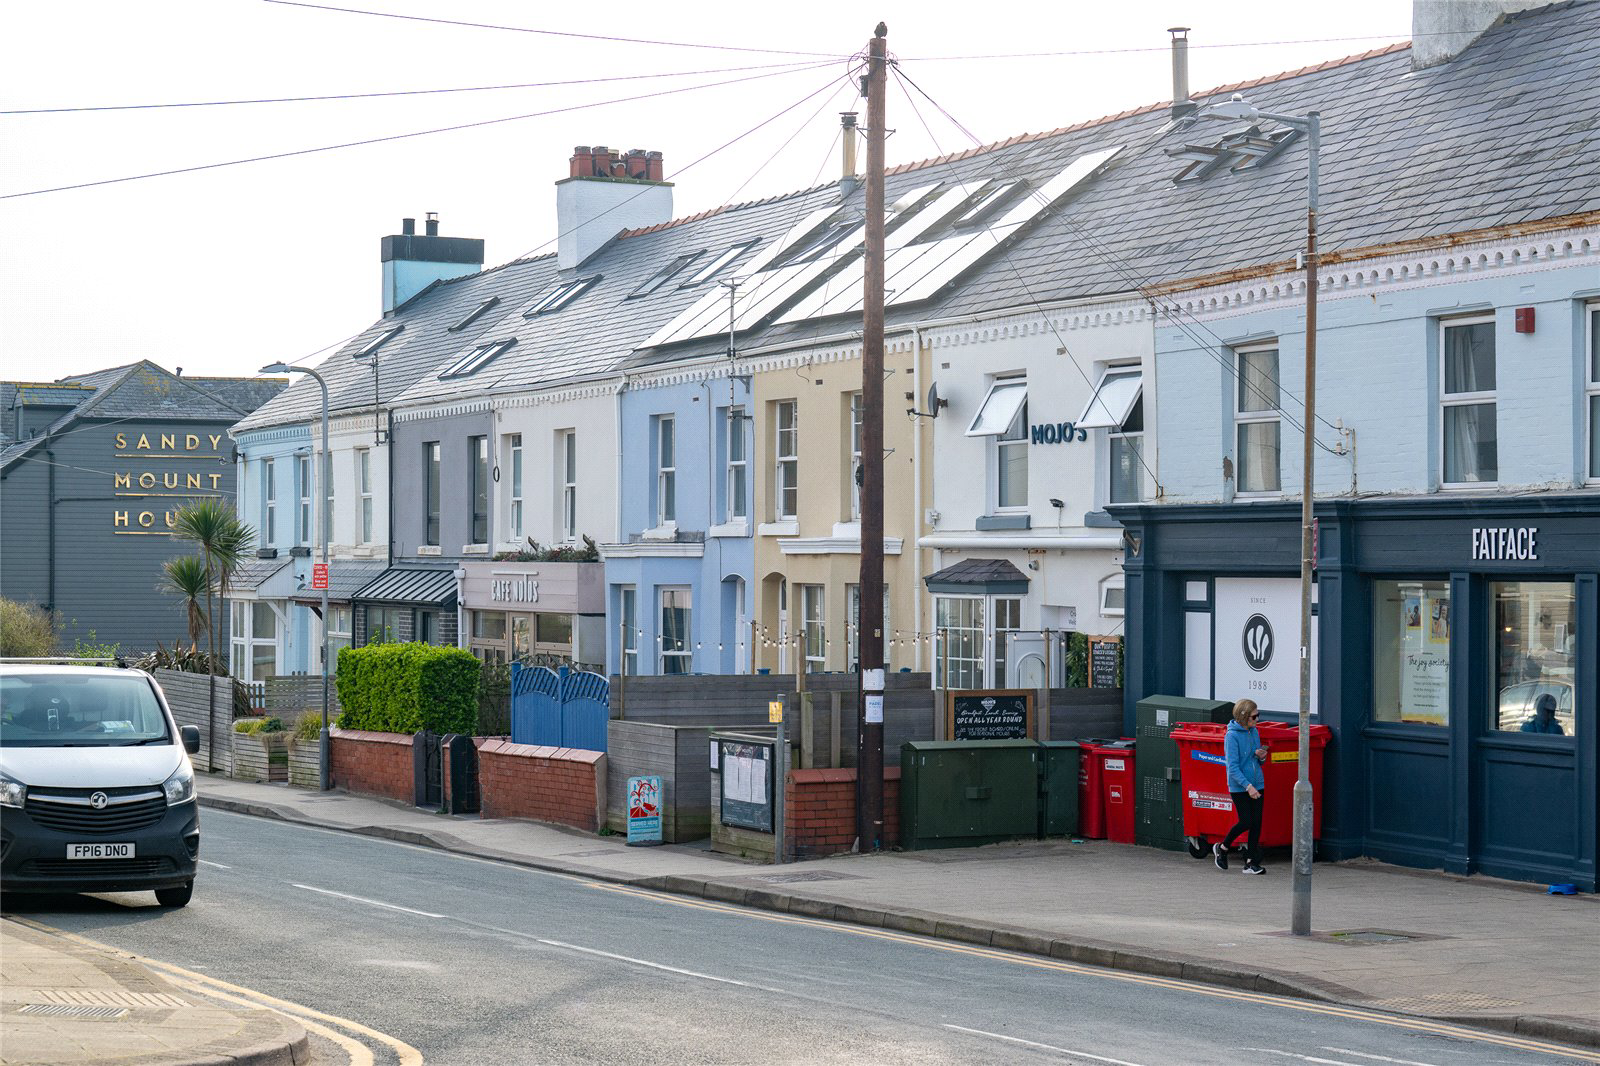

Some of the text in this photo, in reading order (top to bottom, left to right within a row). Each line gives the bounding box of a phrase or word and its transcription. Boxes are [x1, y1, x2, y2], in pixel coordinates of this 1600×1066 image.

[115, 432, 222, 450] SANDY
[114, 472, 222, 489] MOUNT
[114, 511, 180, 528] HOU
[1472, 527, 1538, 560] FATFACE
[1408, 655, 1417, 666] The
[1248, 680, 1268, 691] 1988
[986, 716, 1001, 724] YEAR
[75, 845, 128, 857] FP16 DNO
